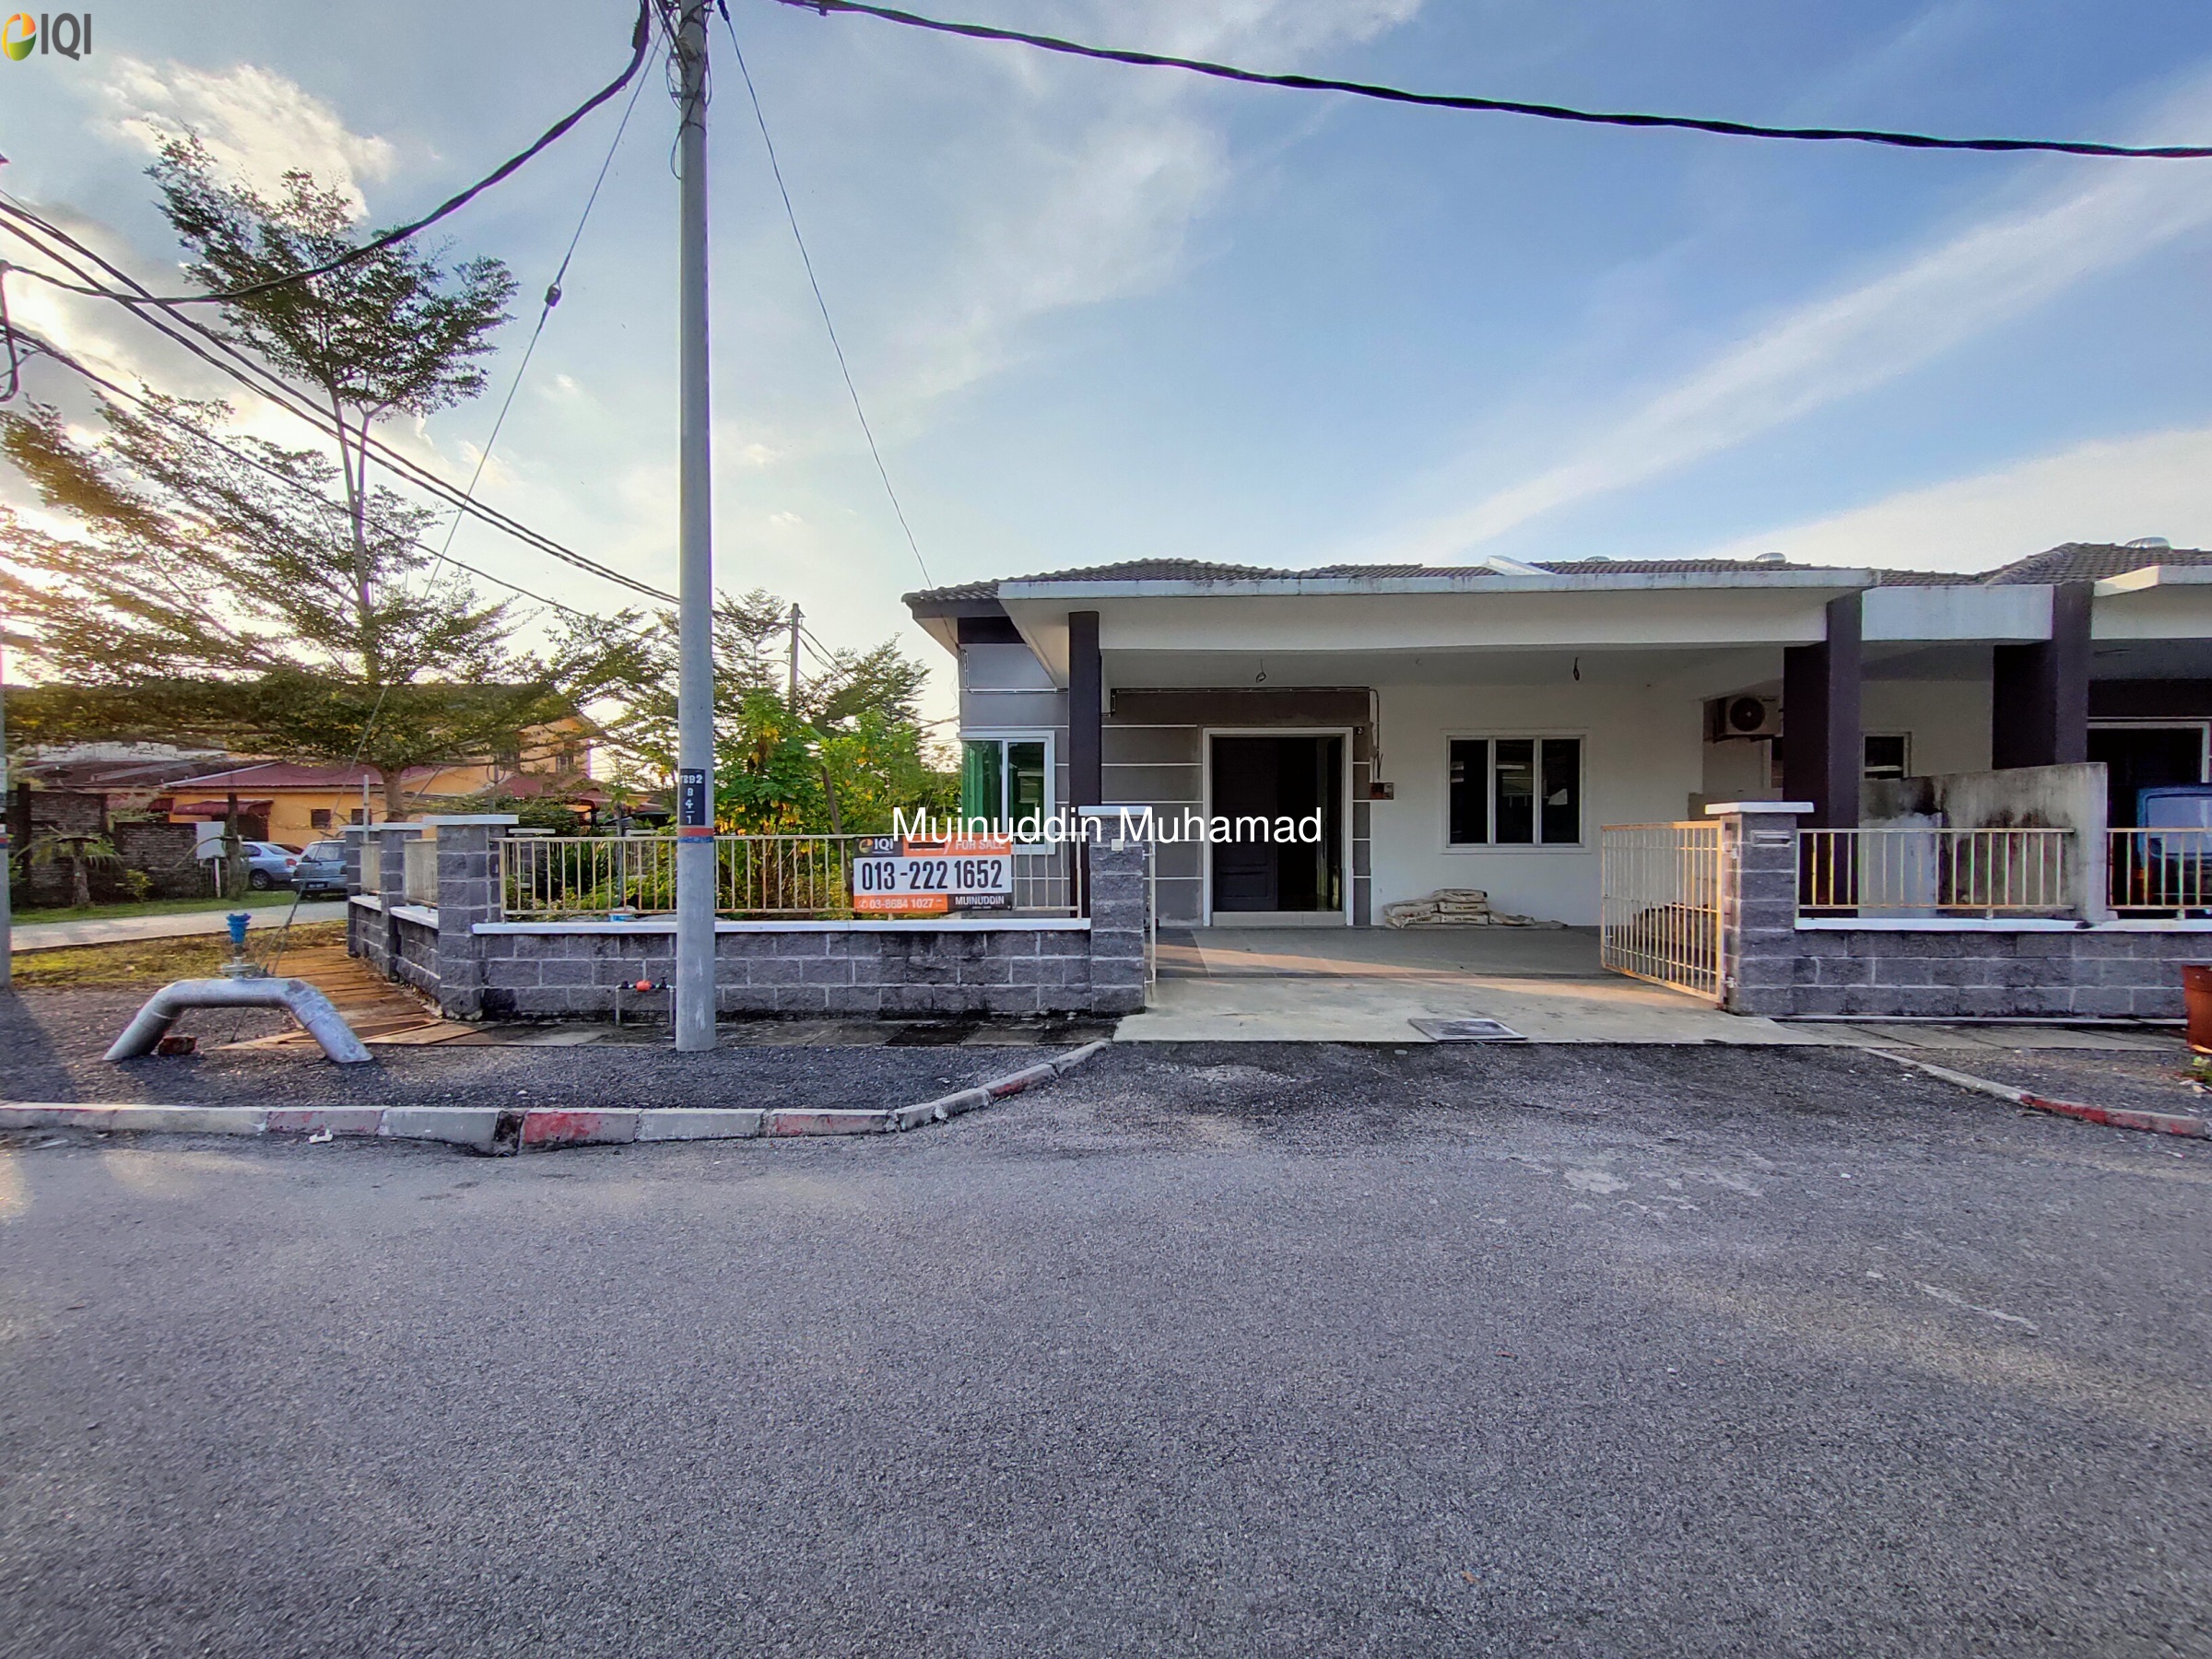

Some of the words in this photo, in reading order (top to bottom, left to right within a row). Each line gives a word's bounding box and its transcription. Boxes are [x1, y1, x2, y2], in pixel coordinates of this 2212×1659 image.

[687, 787, 694, 796] B
[685, 799, 694, 809] 4
[686, 815, 692, 824] 1
[874, 838, 894, 851] IQI
[955, 839, 976, 850] FOR
[954, 859, 1003, 889] 1652
[911, 898, 935, 909] 1027
[955, 895, 1005, 905] MUINUDDIN
